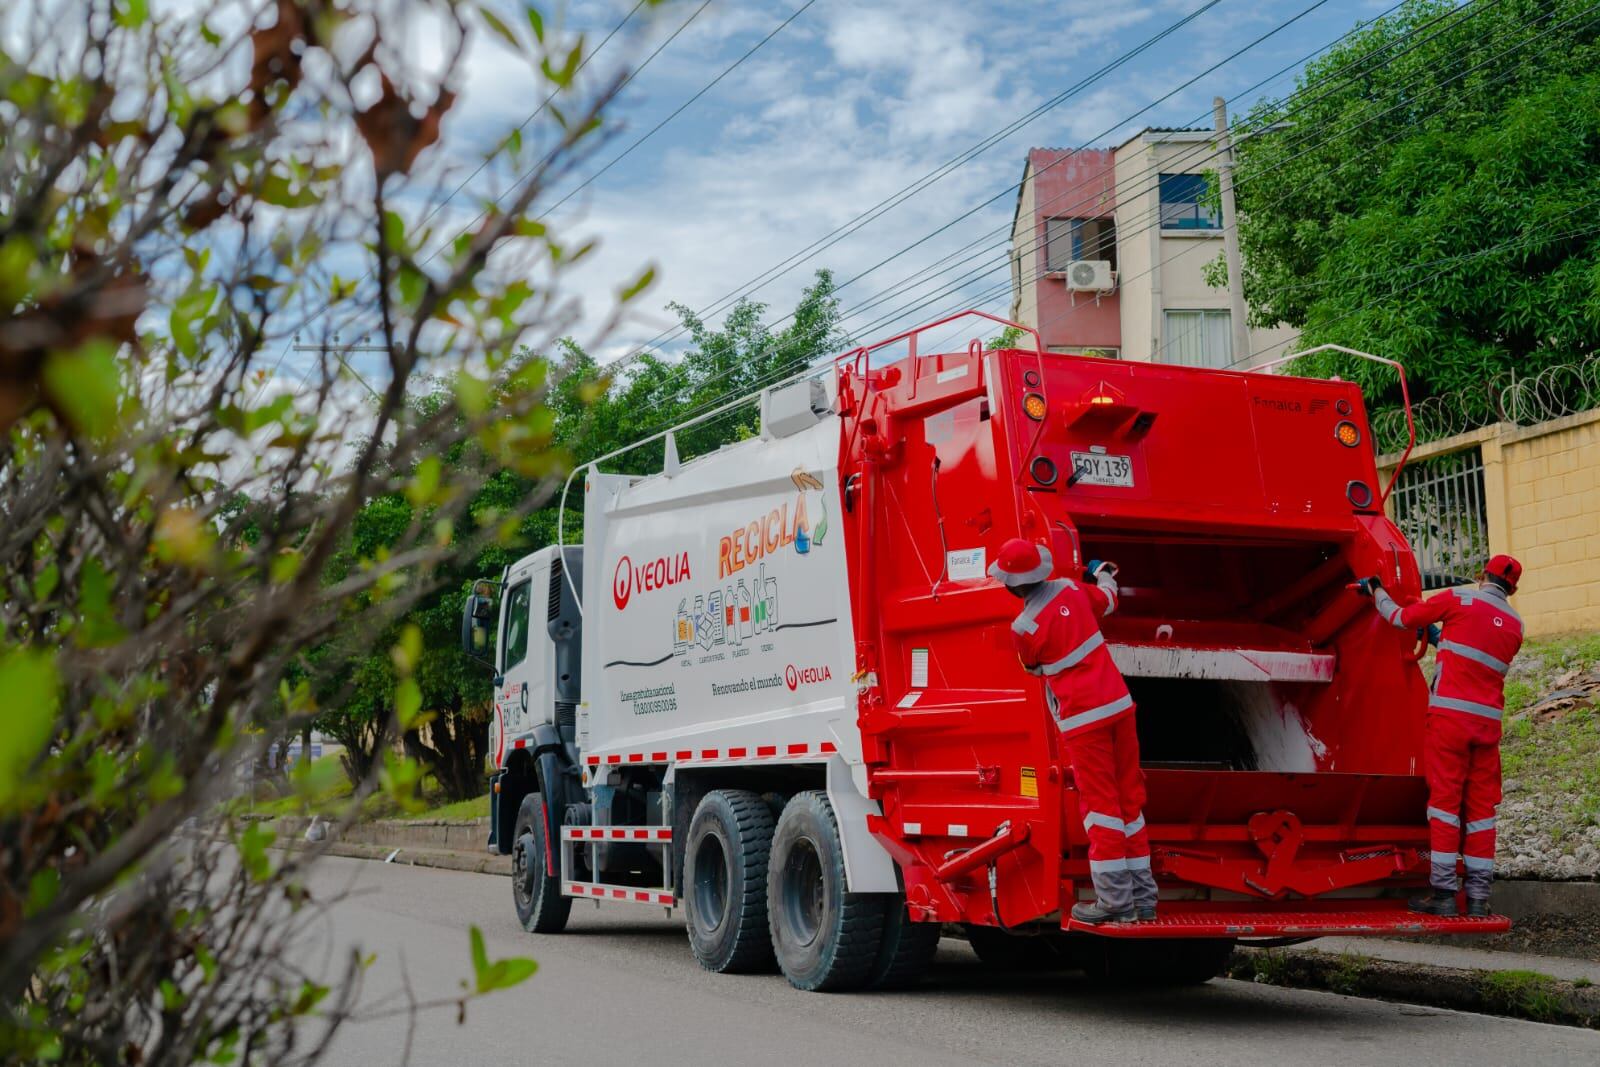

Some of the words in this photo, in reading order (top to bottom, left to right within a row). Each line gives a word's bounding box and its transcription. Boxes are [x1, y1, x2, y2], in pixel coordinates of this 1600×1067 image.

[1105, 460, 1130, 479] 139
[718, 490, 811, 581] RECICLA
[635, 551, 691, 594] VEOLIA
[712, 677, 749, 697] Renovando
[749, 676, 757, 691] el
[757, 673, 783, 689] mundo
[797, 665, 832, 685] VEOLIA
